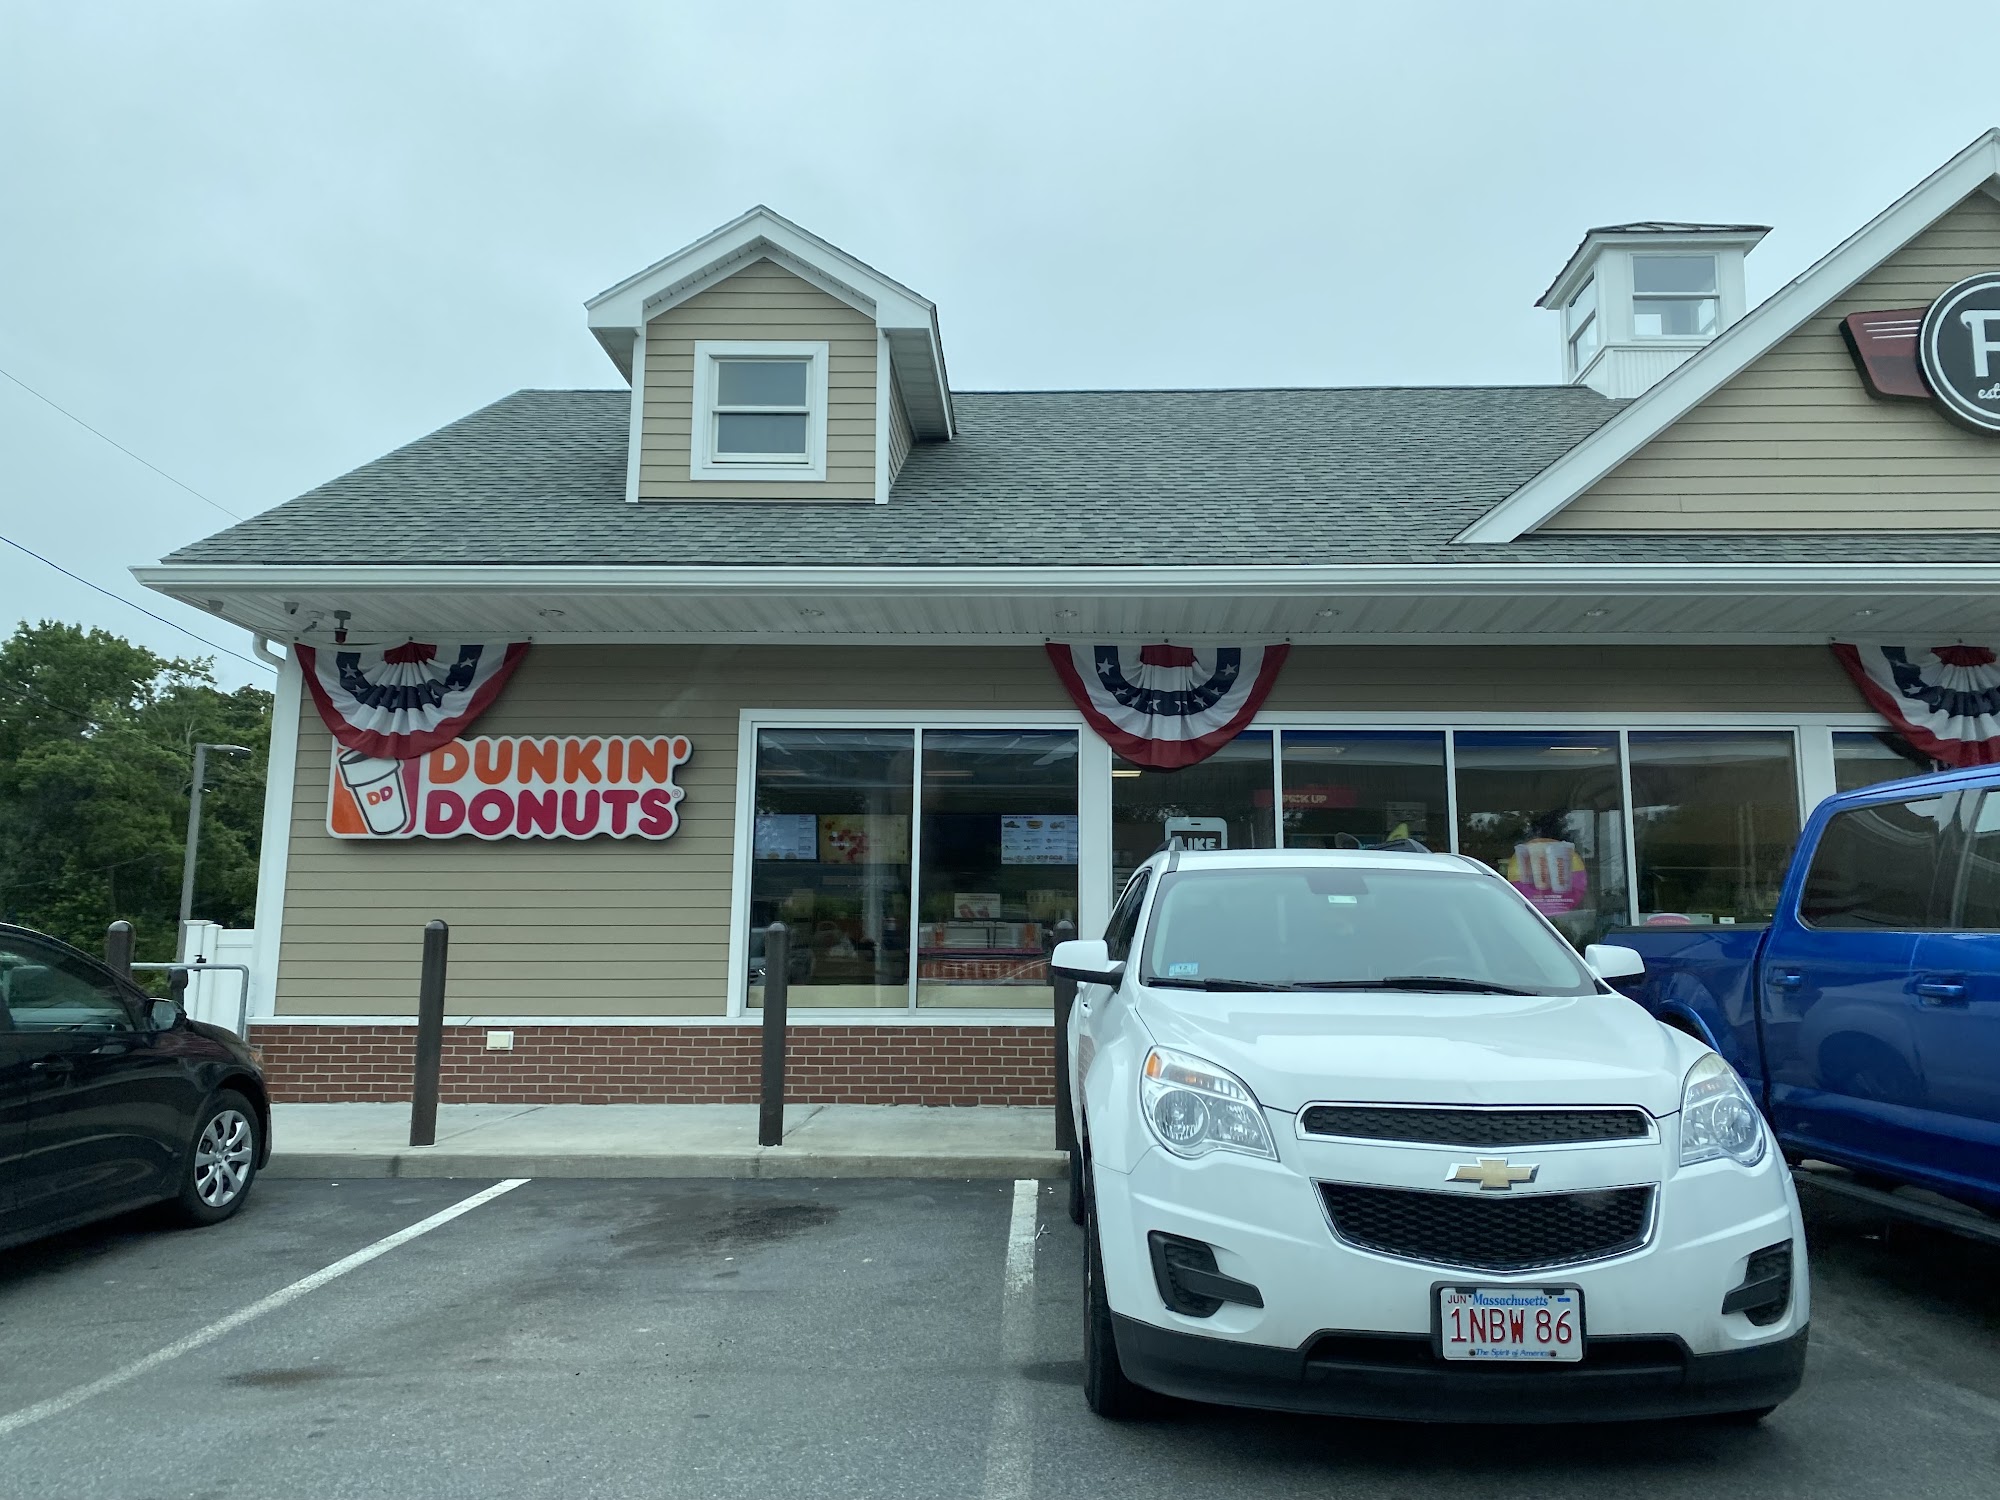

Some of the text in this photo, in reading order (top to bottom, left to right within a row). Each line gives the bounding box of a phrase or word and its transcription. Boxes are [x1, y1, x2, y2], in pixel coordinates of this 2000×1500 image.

[427, 738, 687, 784] DUNKIN'
[366, 786, 393, 806] DD
[1311, 794, 1327, 803] UP
[425, 788, 673, 836] DONUTS
[1182, 837, 1217, 850] IKE
[1447, 1292, 1549, 1306] JUN Massachusetts
[1451, 1308, 1572, 1344] 1NBW 86
[1476, 1348, 1489, 1356] The
[1491, 1347, 1510, 1357] Spirit
[1512, 1348, 1519, 1357] of
